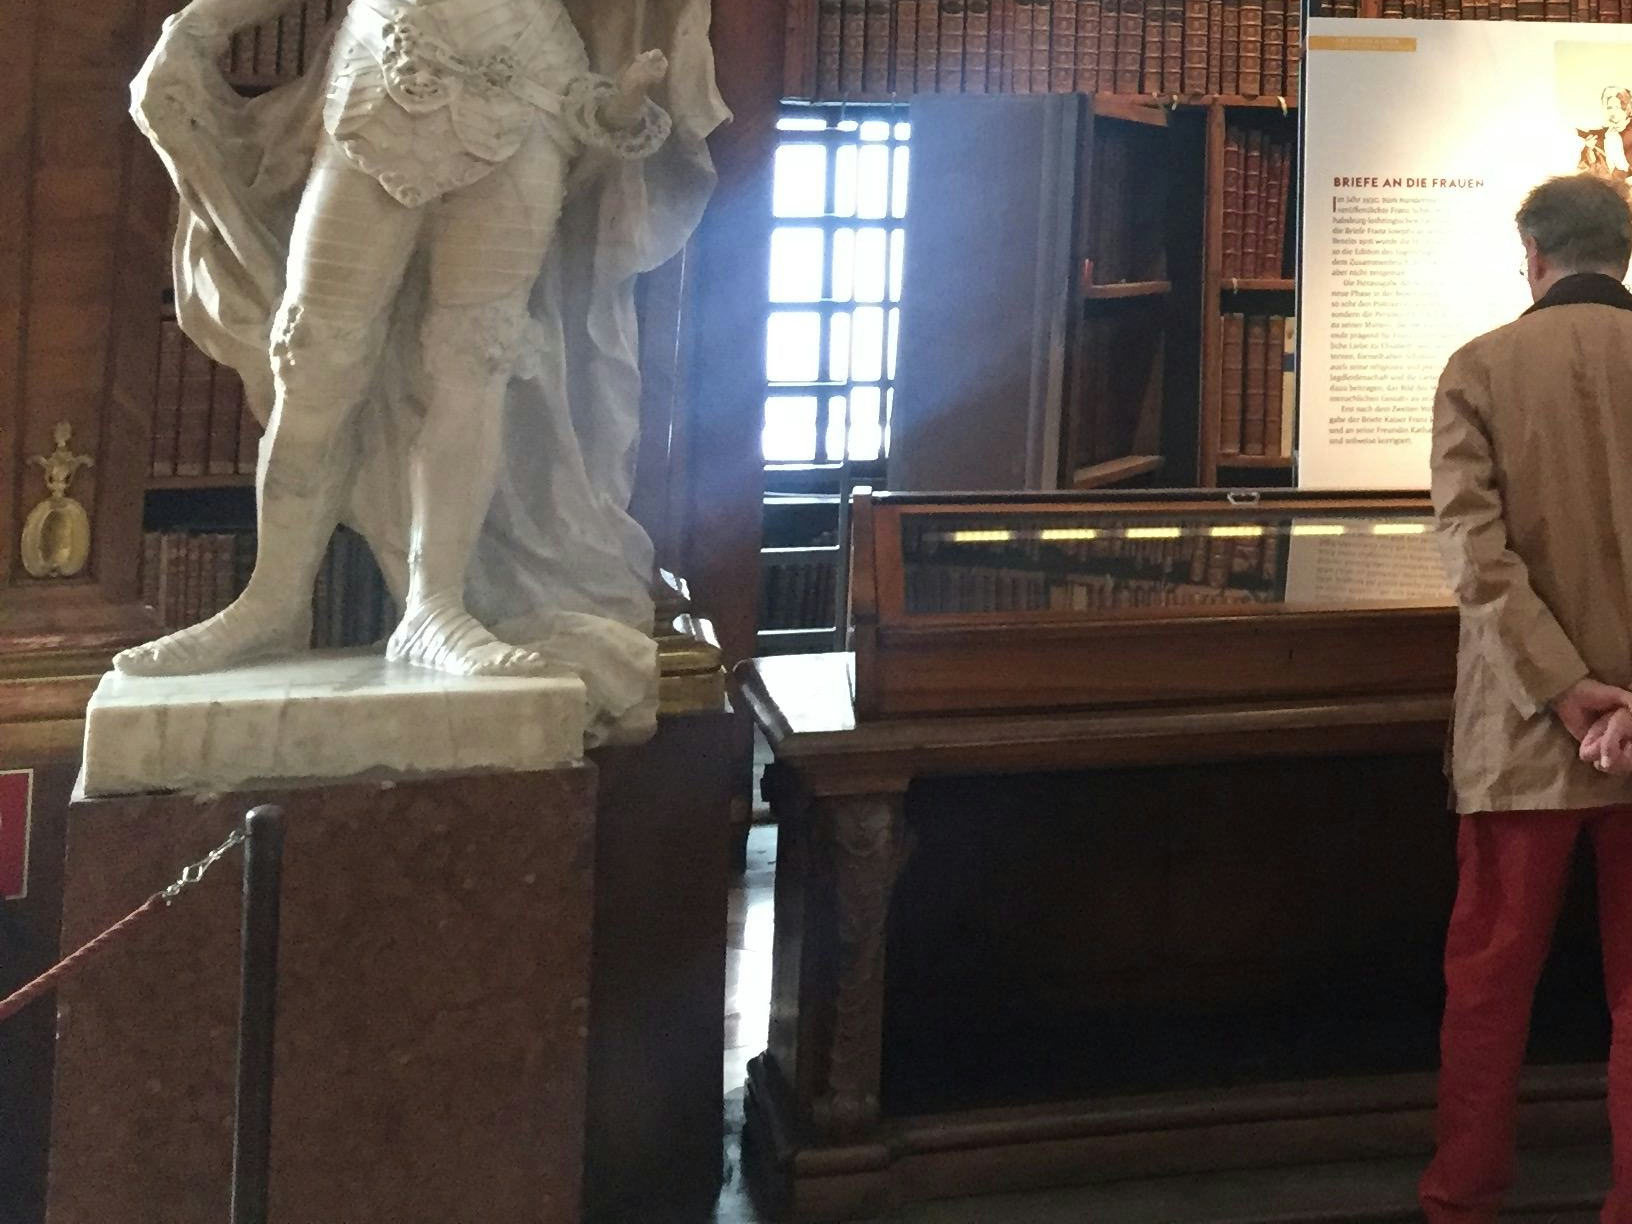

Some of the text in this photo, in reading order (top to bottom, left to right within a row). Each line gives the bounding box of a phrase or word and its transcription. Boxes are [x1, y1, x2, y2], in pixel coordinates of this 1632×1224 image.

[1334, 177, 1484, 188] BRIEFE AN DIE FRAUEN
